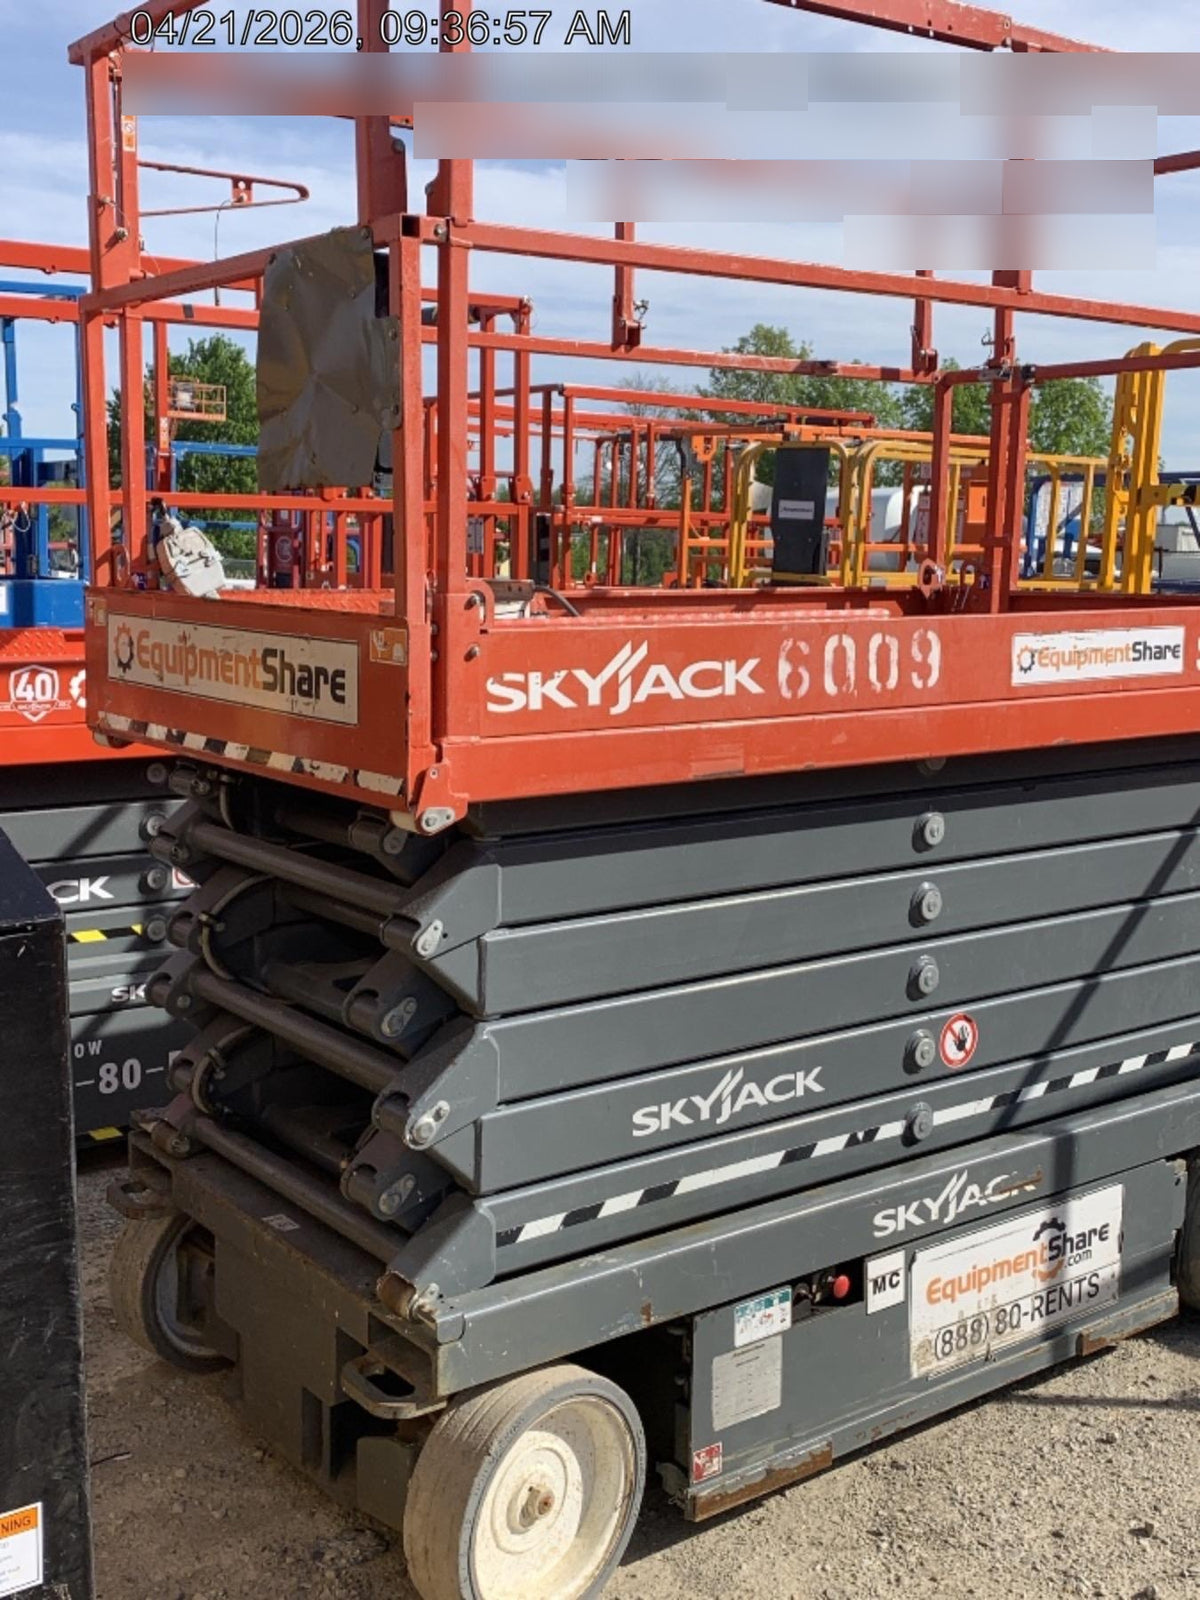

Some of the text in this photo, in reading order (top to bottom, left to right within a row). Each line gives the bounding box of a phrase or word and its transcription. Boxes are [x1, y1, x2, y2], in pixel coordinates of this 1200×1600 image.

[15, 672, 53, 702] 40
[137, 629, 346, 704] EquipmentShare
[486, 640, 765, 715] SKYJACK
[778, 628, 941, 700] 6009
[1037, 640, 1181, 672] EquipmentShare
[632, 1066, 826, 1137] SKYJACK
[872, 1272, 901, 1296] MC
[926, 1222, 1110, 1306] EquipmentShare
[934, 1272, 1100, 1361] (888) 80-RENTS
